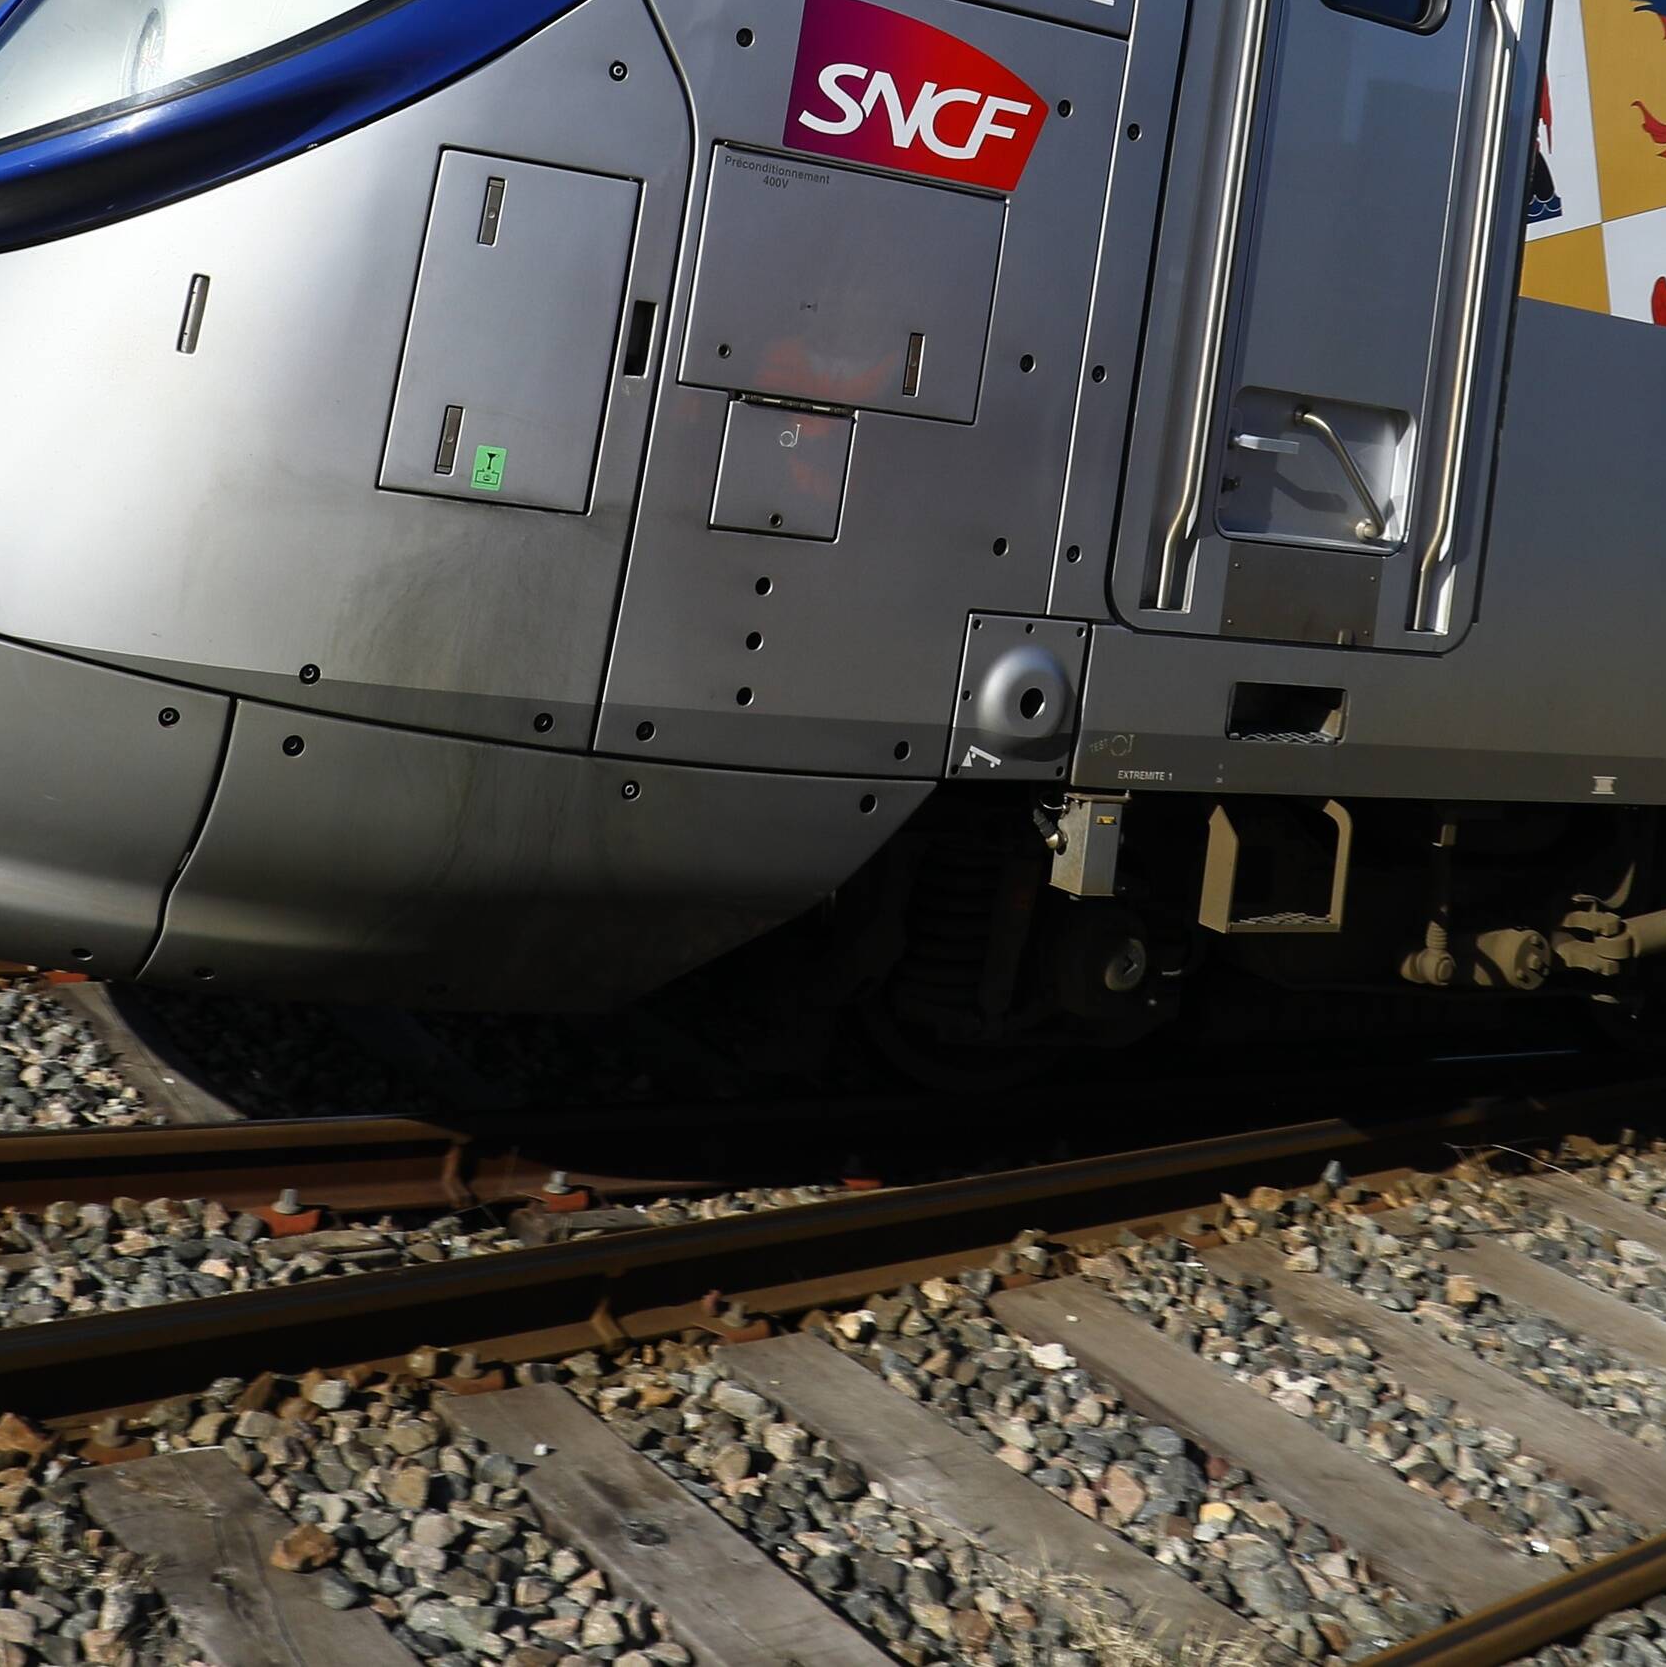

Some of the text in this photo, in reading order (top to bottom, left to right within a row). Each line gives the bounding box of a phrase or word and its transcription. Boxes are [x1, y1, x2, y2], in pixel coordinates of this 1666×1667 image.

[798, 63, 1032, 160] SNCF
[724, 155, 830, 184] Préconditionnement
[763, 175, 789, 189] 400V
[1117, 770, 1165, 781] EXTREMITE
